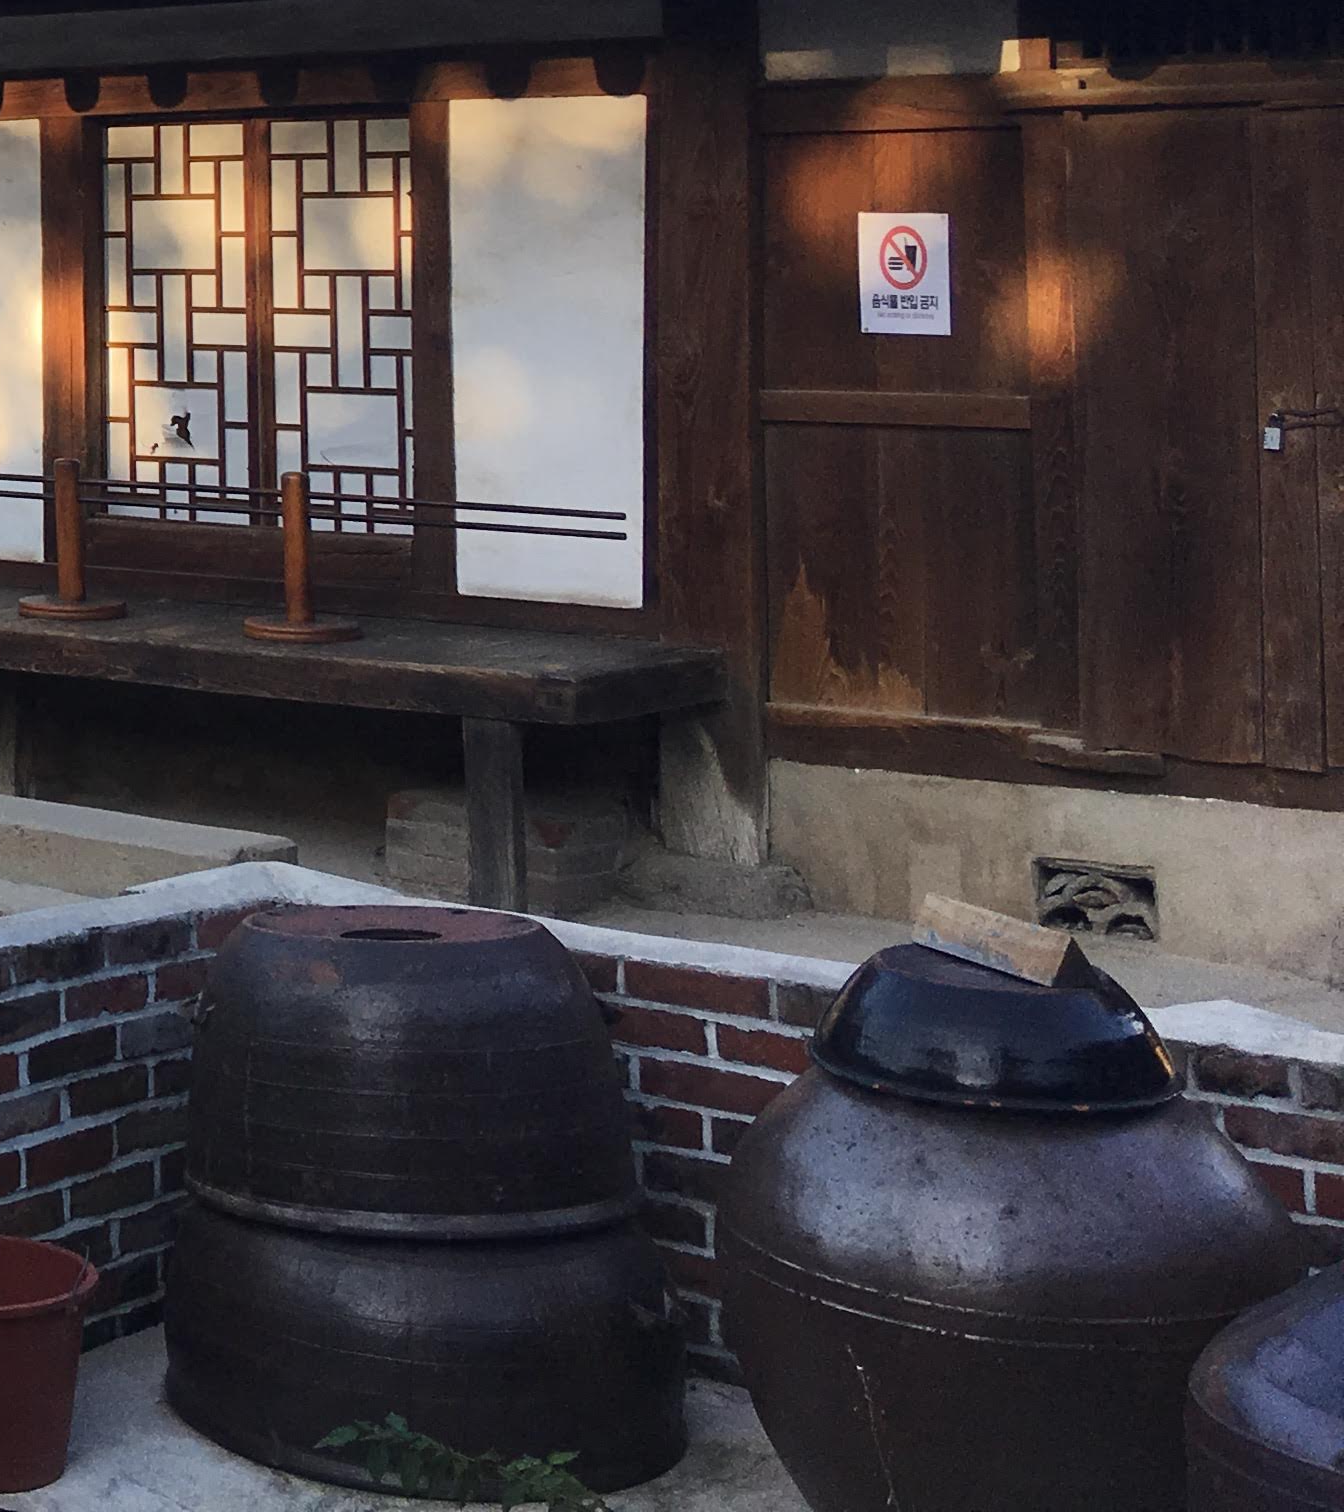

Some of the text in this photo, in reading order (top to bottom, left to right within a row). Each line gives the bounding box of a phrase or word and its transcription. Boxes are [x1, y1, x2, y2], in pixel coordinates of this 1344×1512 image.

[872, 293, 939, 310] 음식물 반입 금지
